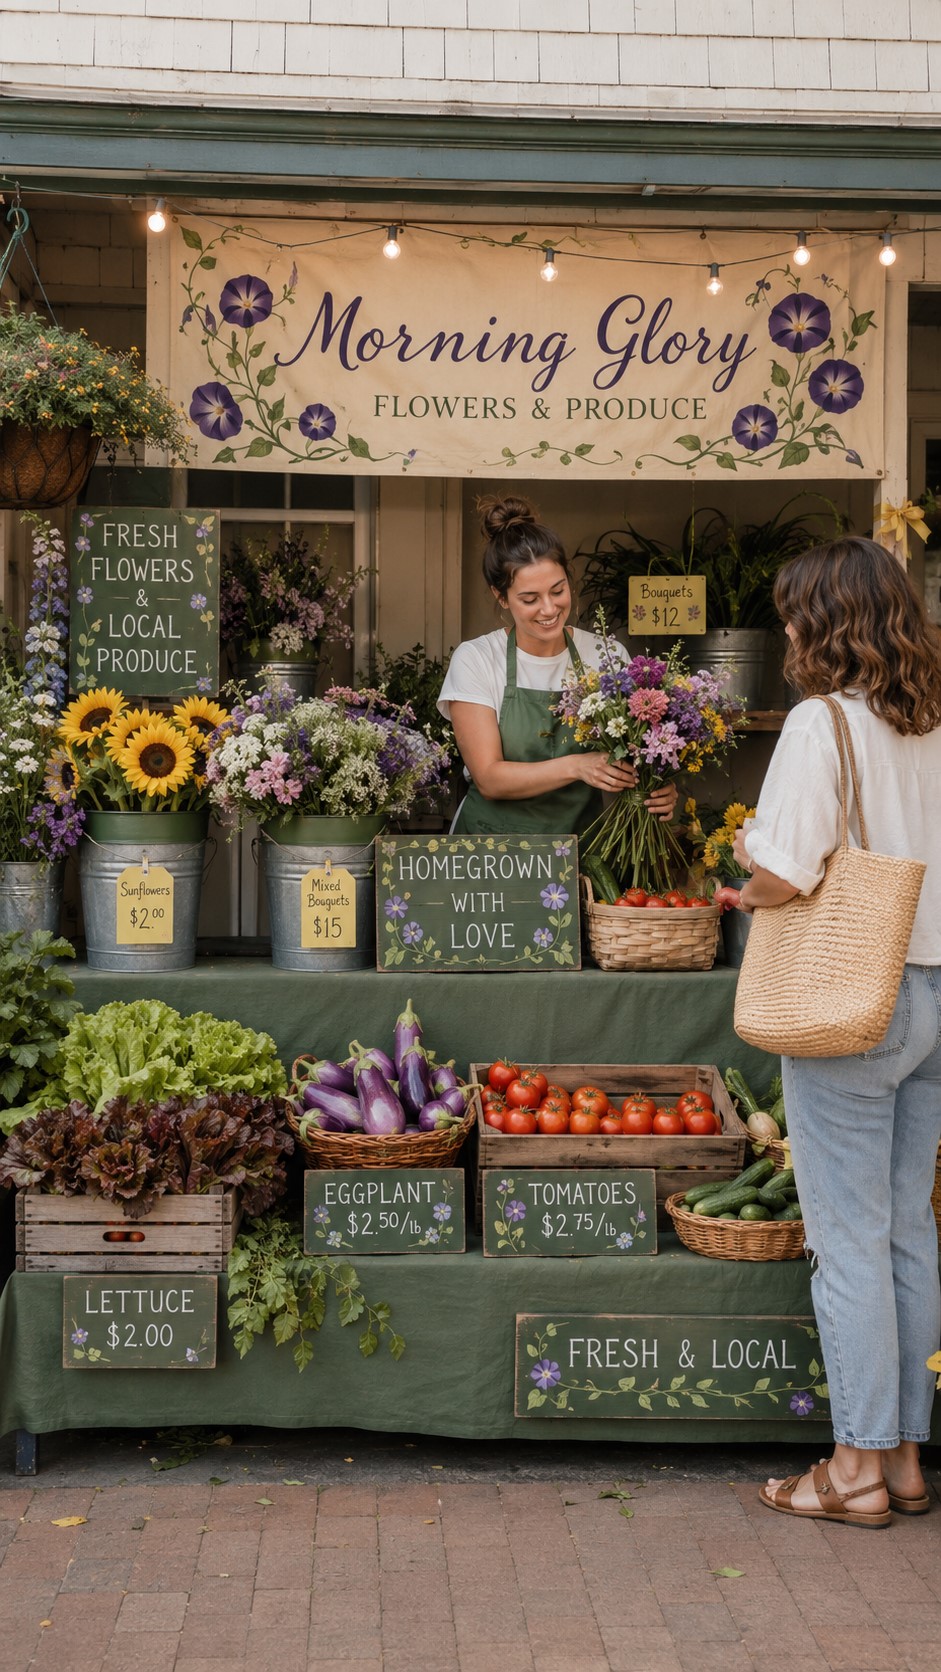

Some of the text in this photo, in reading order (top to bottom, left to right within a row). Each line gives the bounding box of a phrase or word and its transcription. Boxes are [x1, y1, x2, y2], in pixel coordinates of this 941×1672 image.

[274, 291, 757, 393] Morning Glory
[373, 395, 708, 421] FLOWERS & PRODUCE
[103, 523, 178, 548] FRESH
[91, 557, 194, 583] FLOWERS
[136, 588, 149, 607] &
[641, 583, 693, 603] Bouquets
[109, 614, 181, 639] LOCAL
[652, 605, 681, 627] $12
[97, 648, 197, 674] PRODUCE
[399, 854, 552, 880] HOMEGROWN
[120, 881, 170, 900] Sunflowers
[311, 878, 341, 892] Mixed
[451, 892, 505, 913] WITH
[130, 907, 165, 929] $2.00
[313, 916, 342, 938] $15
[450, 923, 515, 949] LOVE
[324, 1181, 436, 1205] EGGPLANT
[528, 1182, 636, 1206] TOMATOES
[347, 1211, 422, 1238] $2.50/lb
[541, 1212, 617, 1239] $2.75/lb
[85, 1289, 195, 1314] LETTUCE
[106, 1321, 173, 1350] $2.00
[569, 1338, 797, 1369] FRESH & LOCAL
